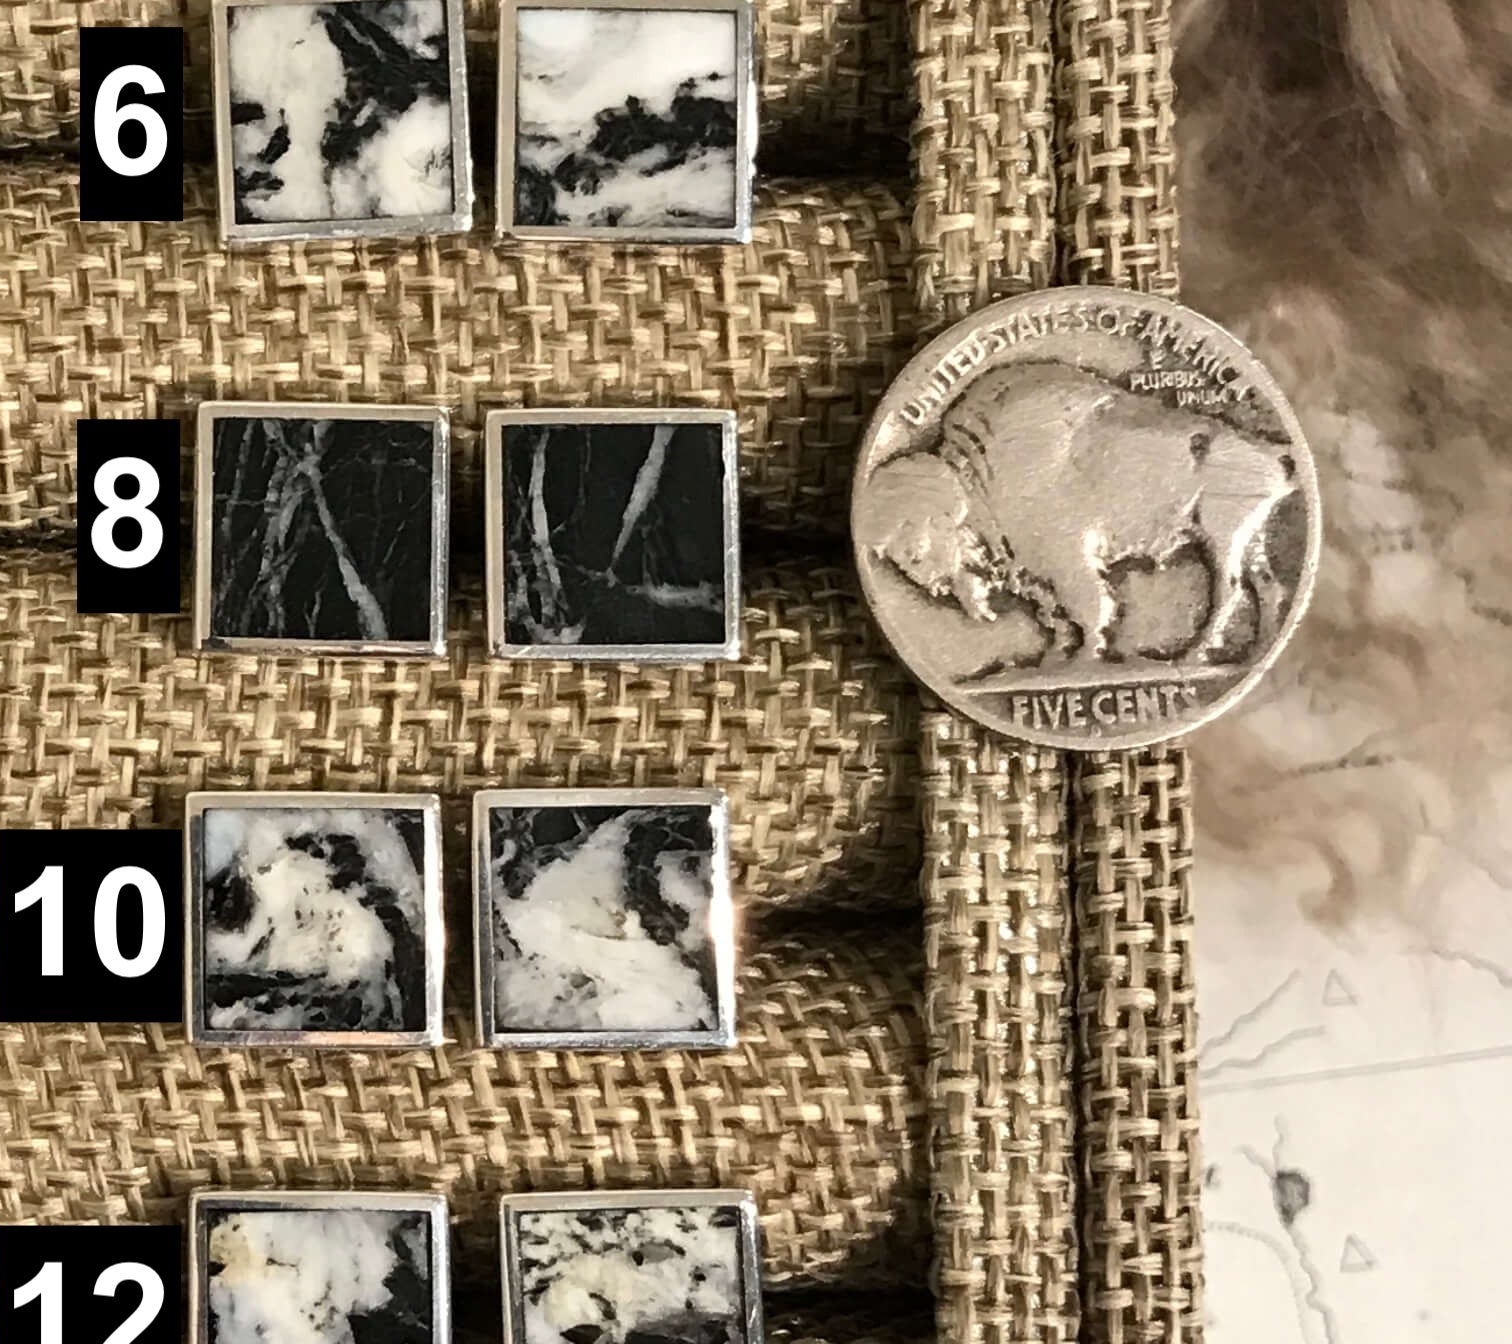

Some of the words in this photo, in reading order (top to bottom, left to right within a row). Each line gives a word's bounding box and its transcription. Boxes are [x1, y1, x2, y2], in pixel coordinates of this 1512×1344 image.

[899, 327, 986, 425] UNITED
[987, 303, 1090, 354] STATES
[1011, 690, 1088, 730] FIVE
[1091, 683, 1199, 725] CENTS
